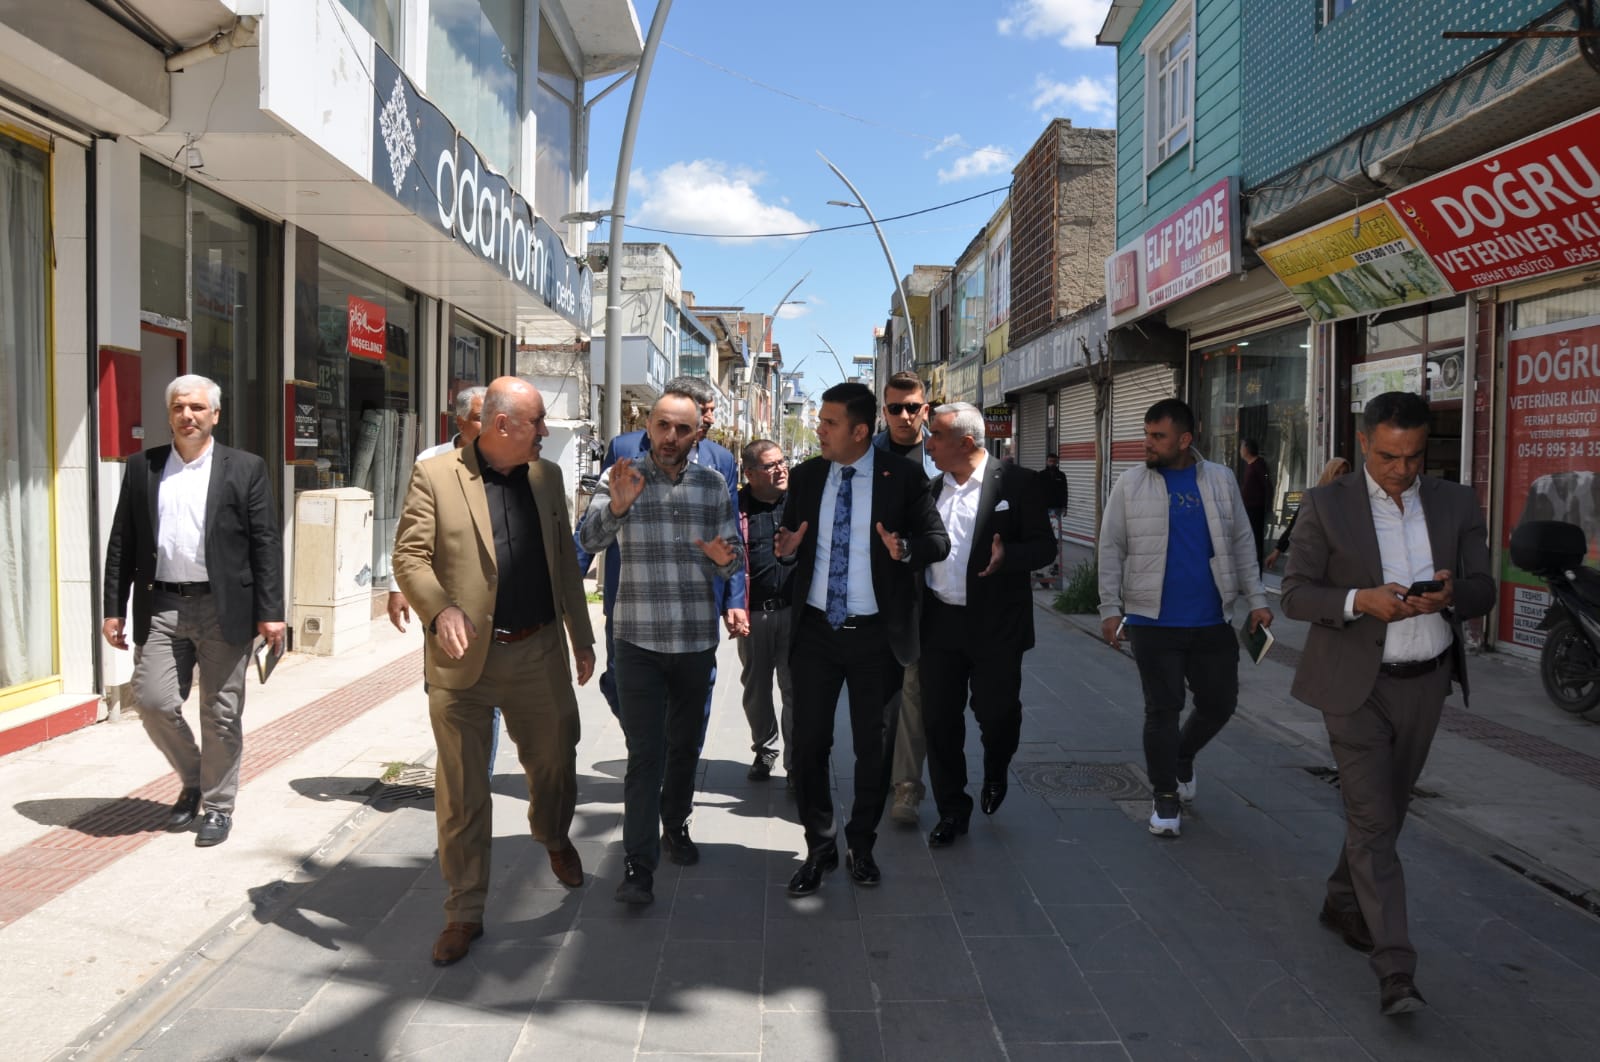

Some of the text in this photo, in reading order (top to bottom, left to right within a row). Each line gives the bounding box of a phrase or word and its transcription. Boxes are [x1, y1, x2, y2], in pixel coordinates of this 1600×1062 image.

[1431, 145, 1600, 239] DOĞRU
[1175, 188, 1225, 258] PERDE
[1360, 208, 1402, 249] YERİ
[1434, 200, 1600, 274] VETERİNER KL
[1395, 241, 1406, 253] 17
[1471, 244, 1599, 285] FERHAT BASÜTÇÜ 0545
[1510, 386, 1600, 410] VETERİNER KLİN
[1524, 409, 1597, 426] FERHAT BASÜTÇÜ
[1518, 443, 1543, 458] 0545
[1546, 442, 1566, 457] 895
[1569, 441, 1584, 457] 34
